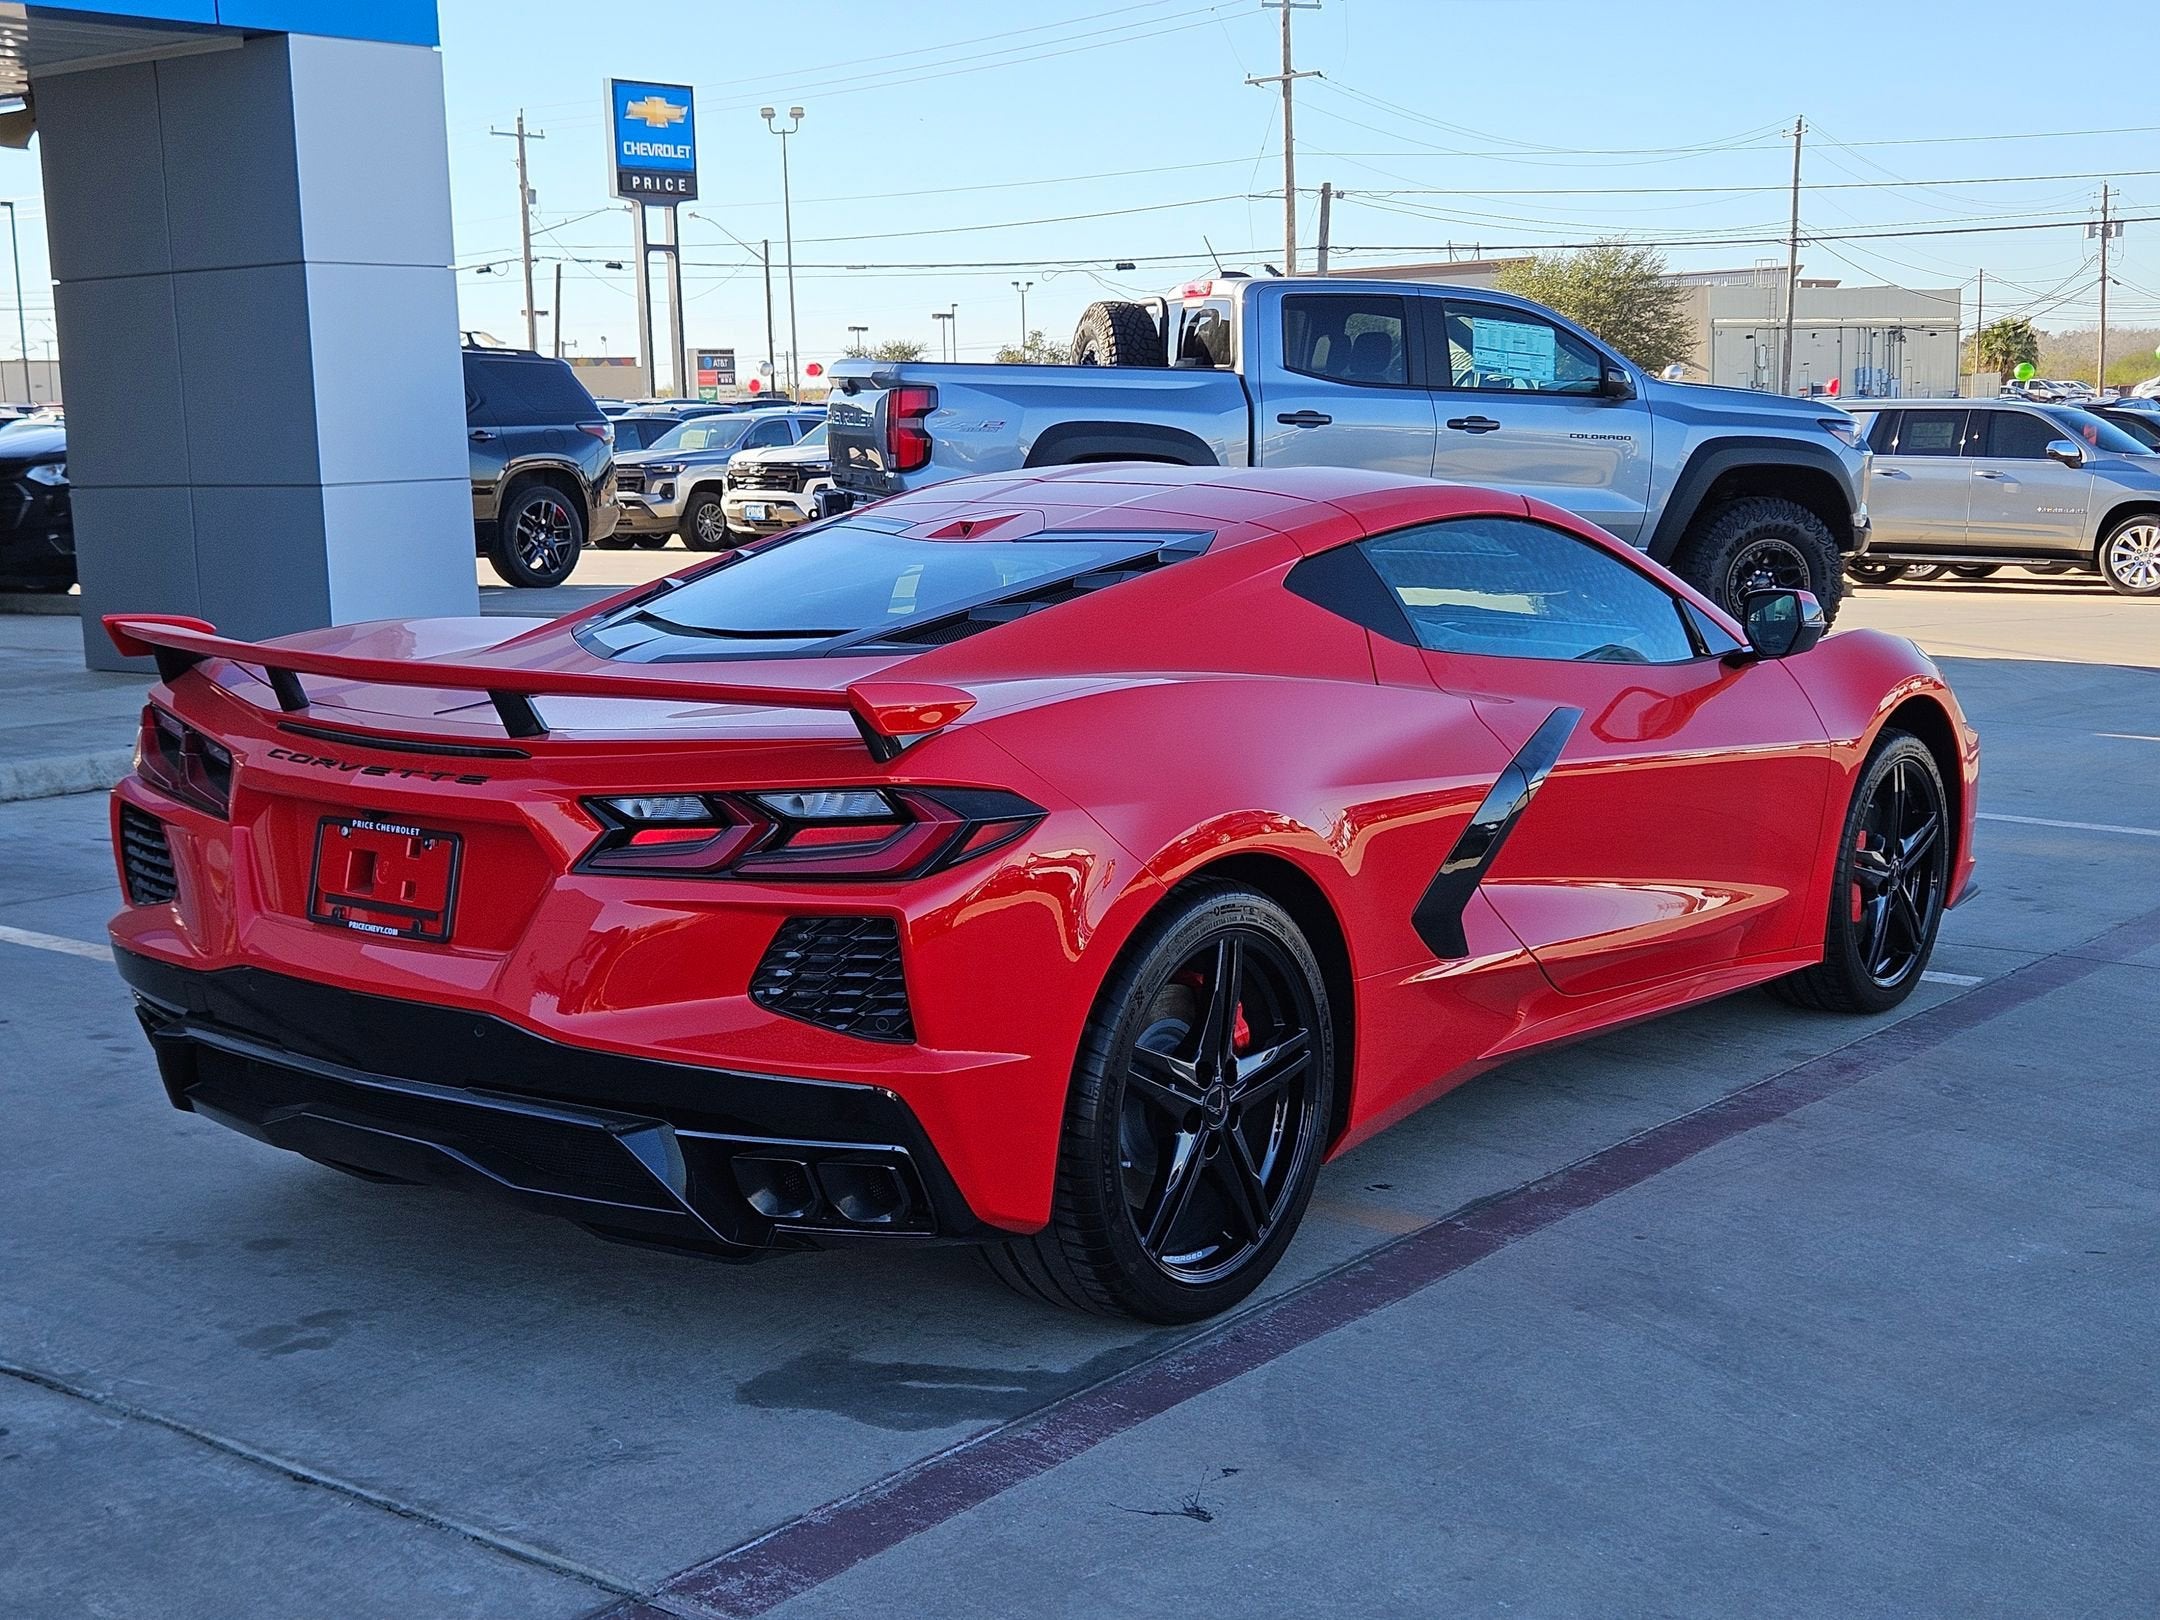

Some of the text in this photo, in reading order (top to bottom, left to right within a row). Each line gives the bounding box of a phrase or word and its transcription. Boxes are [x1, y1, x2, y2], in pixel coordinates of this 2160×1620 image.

[623, 141, 691, 159] CHEVROLET
[632, 176, 686, 192] PRICE
[713, 358, 729, 368] AT&T
[1569, 433, 1632, 441] COLORADO
[267, 748, 490, 785] CORVETTE
[352, 819, 420, 836] PRICE CHEVROLET
[348, 920, 398, 936] PRICECHEVY.COM
